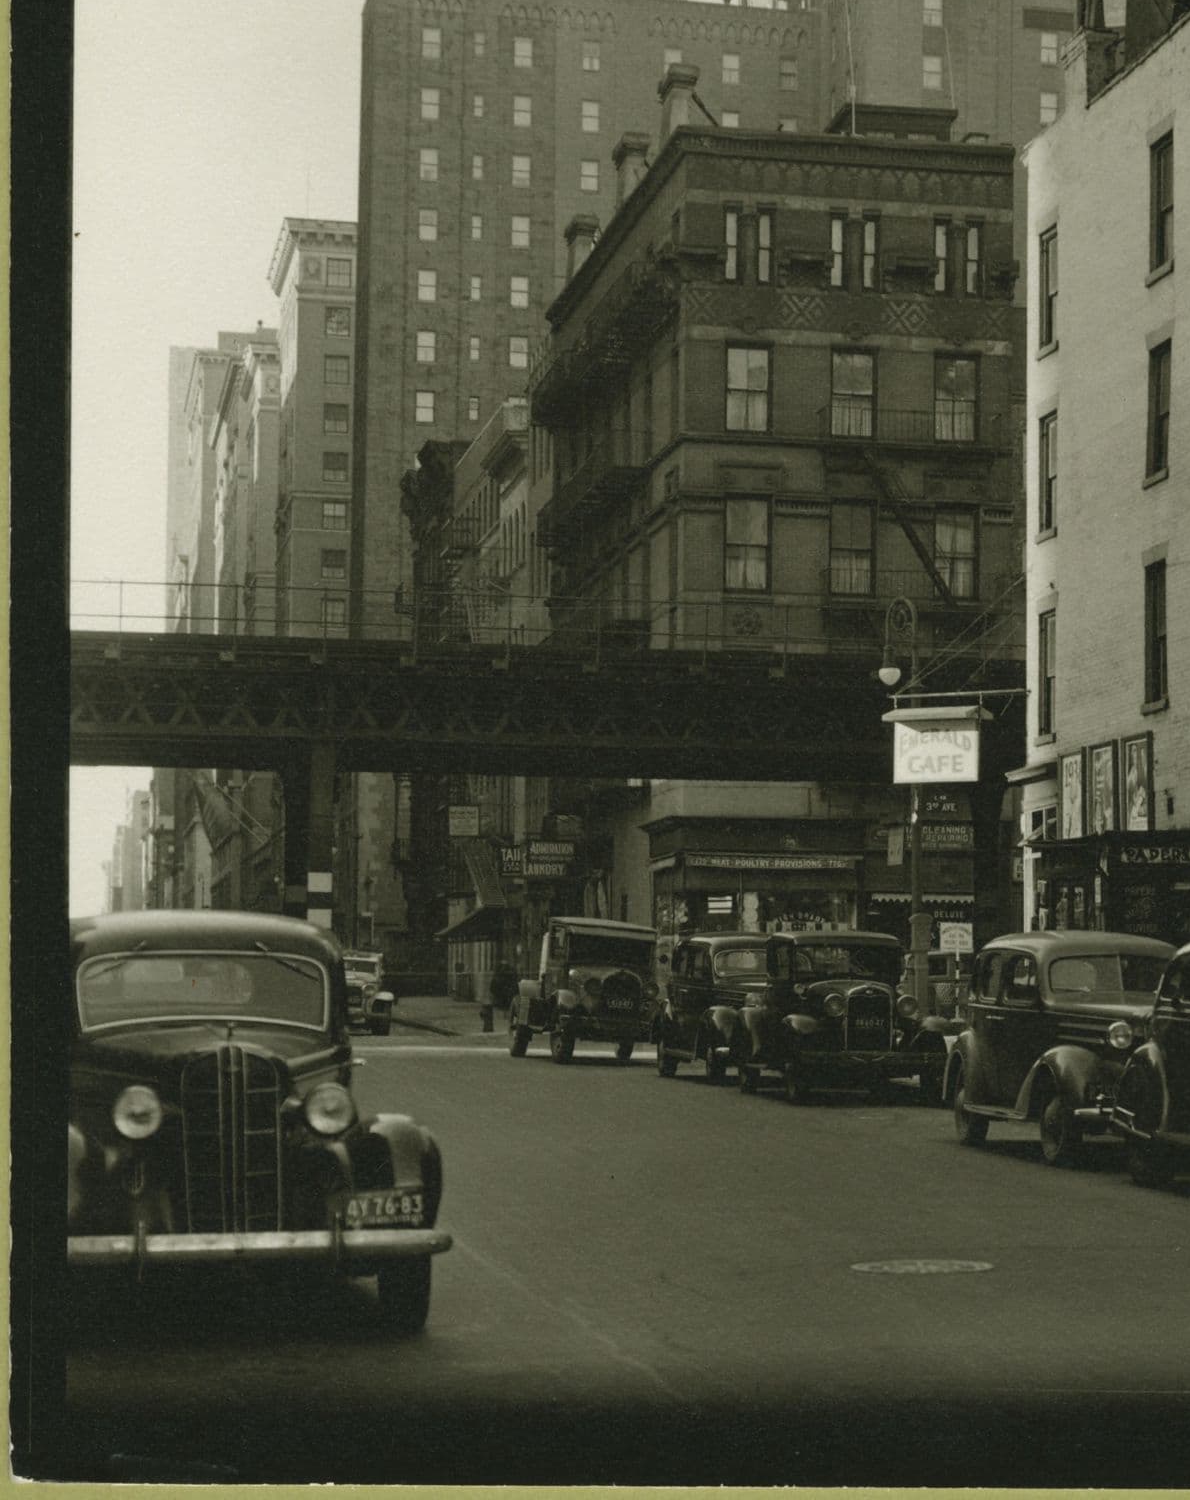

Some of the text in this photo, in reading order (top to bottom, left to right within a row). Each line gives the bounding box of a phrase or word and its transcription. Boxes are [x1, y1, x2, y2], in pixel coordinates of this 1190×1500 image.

[907, 754, 964, 774] CAFE
[735, 858, 771, 869] POULTRY
[774, 859, 822, 869] PROVISIONS
[347, 1198, 369, 1217] 4Y
